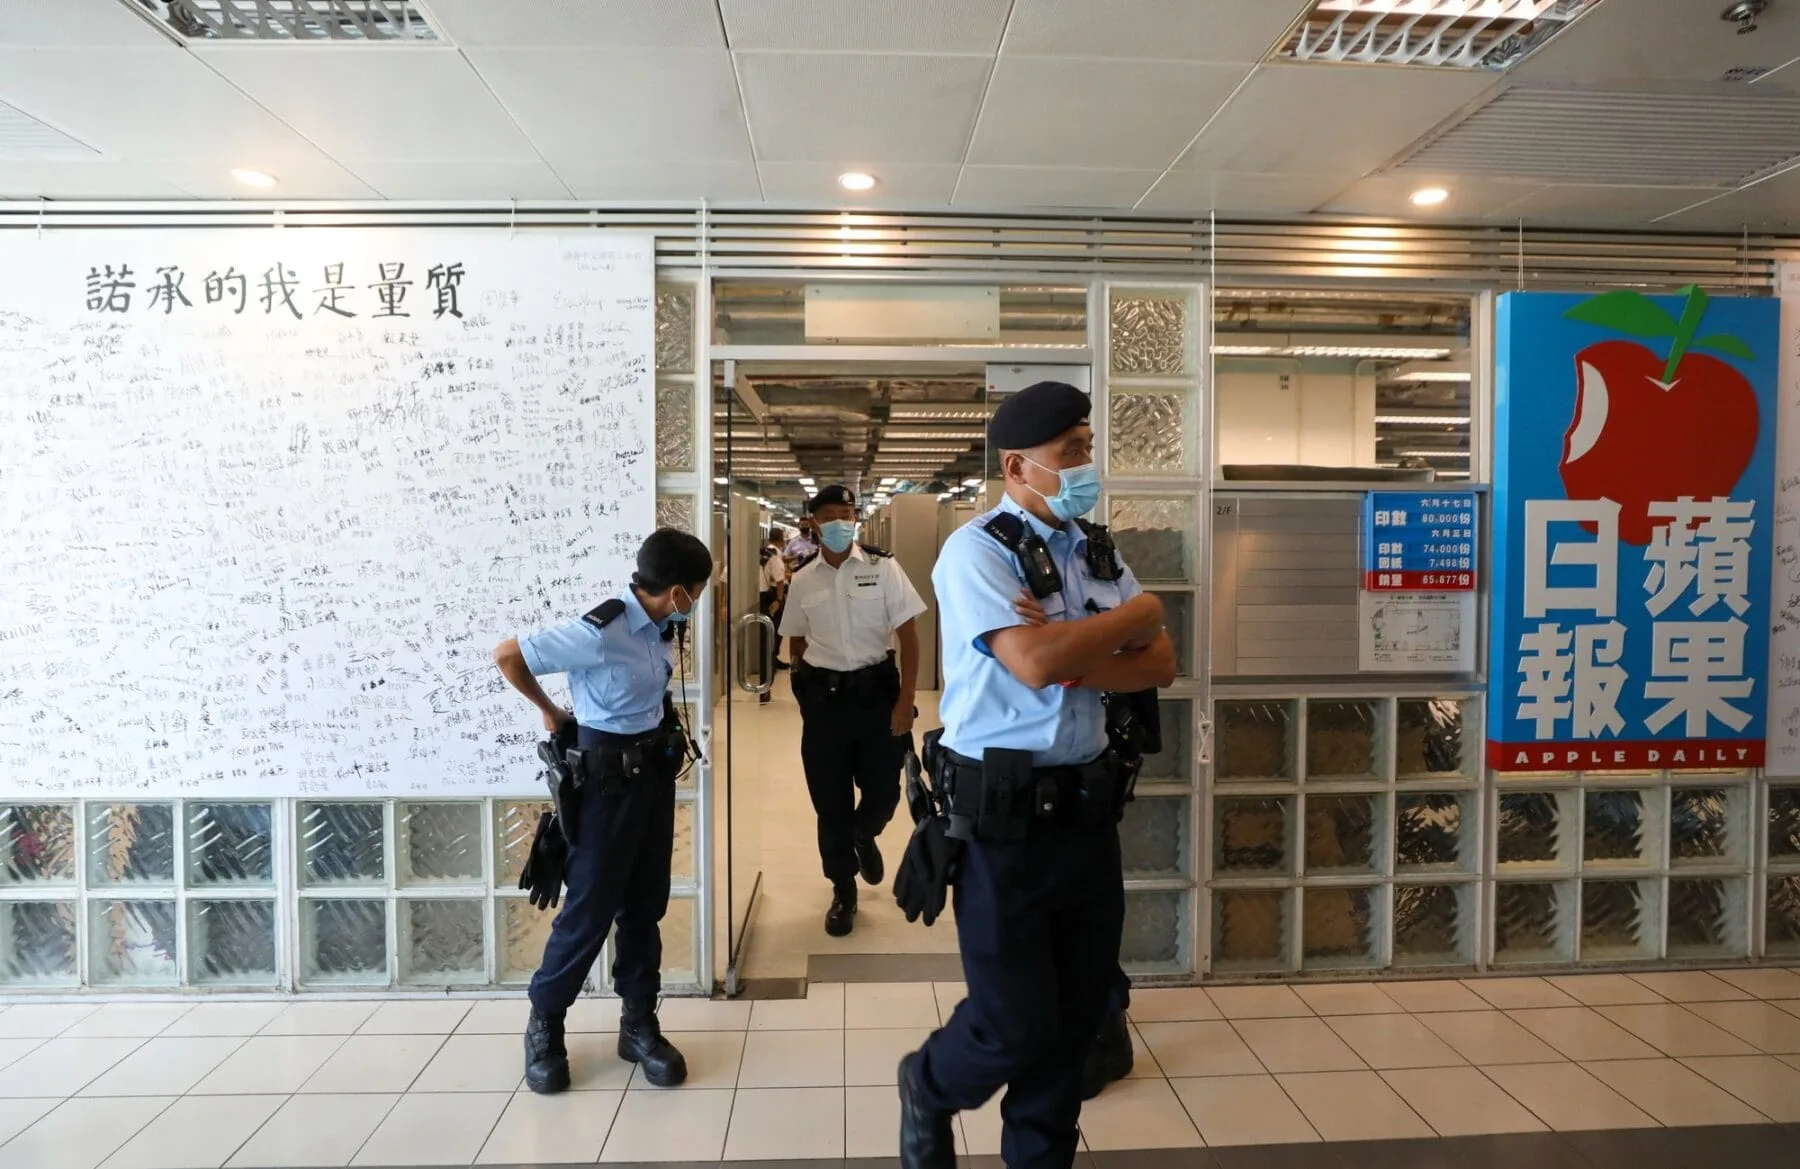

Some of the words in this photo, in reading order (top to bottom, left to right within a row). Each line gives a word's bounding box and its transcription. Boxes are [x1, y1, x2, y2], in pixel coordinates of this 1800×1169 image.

[1421, 499, 1471, 508] 六月十七日
[1216, 505, 1232, 515] 2/F
[1515, 750, 1626, 764] APPLE
[1648, 748, 1749, 763] DAILY
